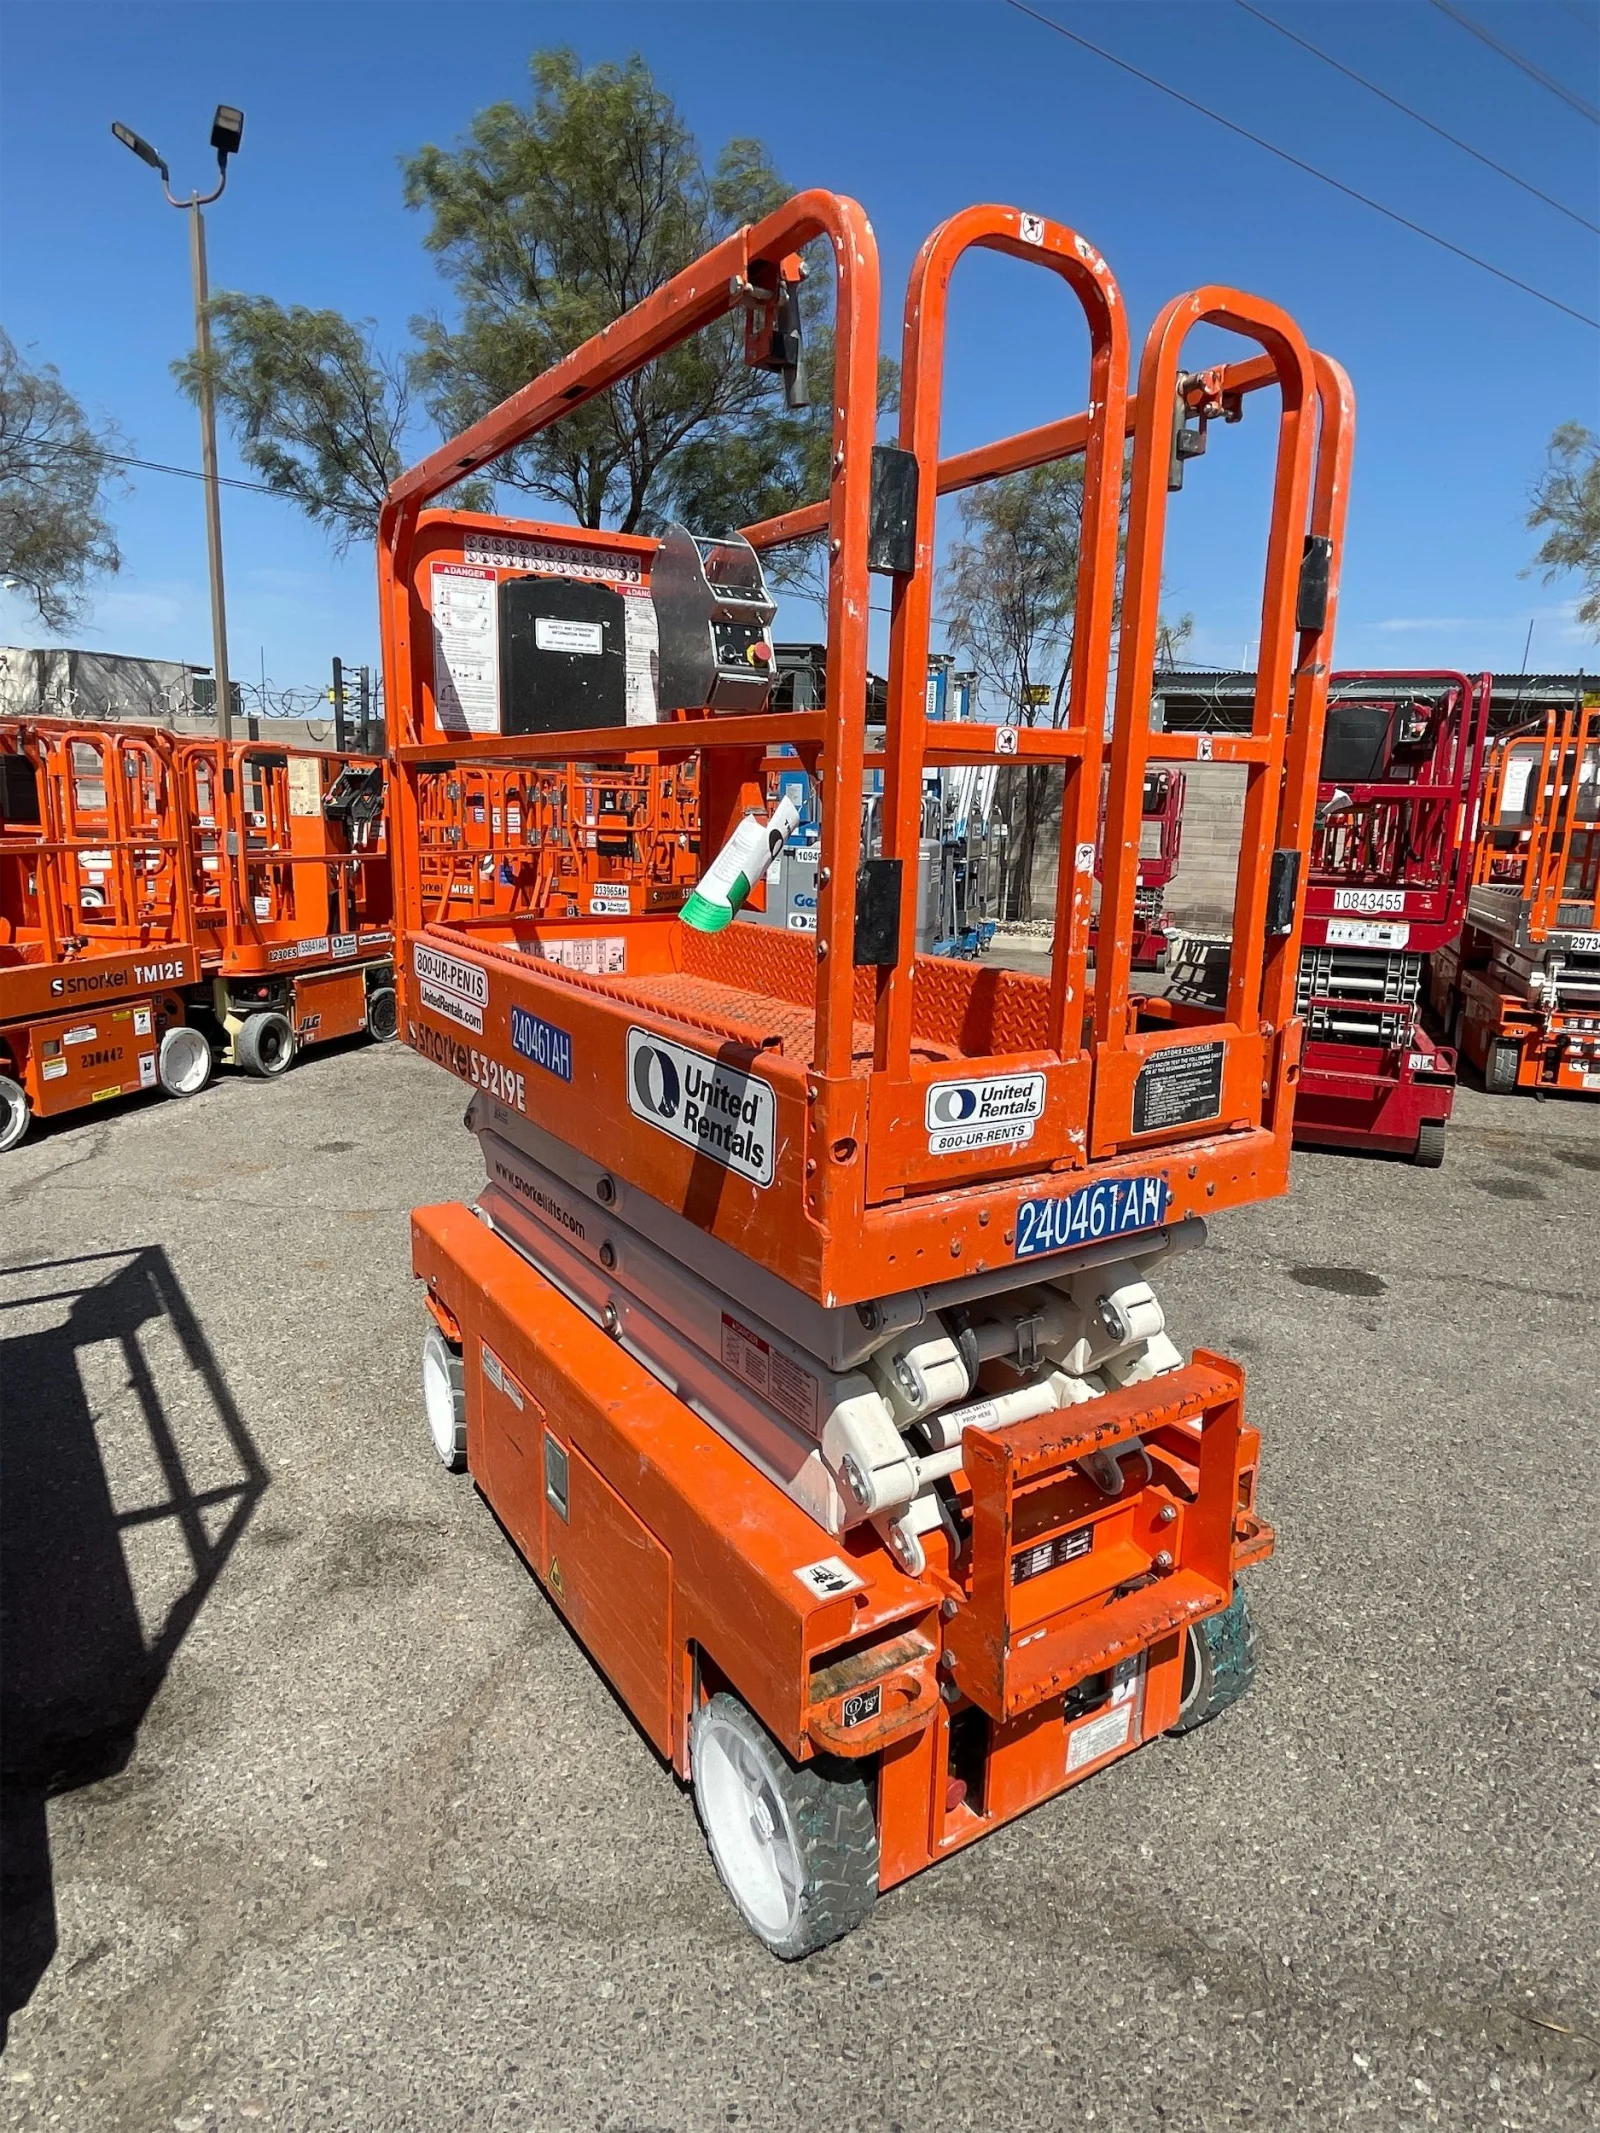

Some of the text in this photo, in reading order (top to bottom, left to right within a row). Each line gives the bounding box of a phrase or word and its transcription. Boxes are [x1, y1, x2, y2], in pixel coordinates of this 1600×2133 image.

[450, 565, 486, 579] DANGER
[1336, 892, 1402, 911] 10843455
[268, 947, 298, 961] 1230ES
[67, 960, 184, 994] snorkel TM12E
[417, 952, 484, 998] 800-UR-PENIS
[299, 1014, 321, 1031] JLG
[422, 986, 482, 1030] UnitedRentals.com
[512, 1010, 569, 1079] 240461AH
[1183, 1043, 1214, 1054] CHECKLIST
[470, 1049, 526, 1112] S3219E
[981, 1082, 1034, 1102] United
[684, 1064, 760, 1127] United
[979, 1097, 1037, 1119] Rentals
[683, 1099, 765, 1168] Rentals
[938, 1125, 1025, 1149] 800-UR-RENTS
[494, 1159, 586, 1241] www.snorkellifts.com
[1017, 1177, 1162, 1255] 240461AH
[962, 1410, 991, 1423] PROP HERE
